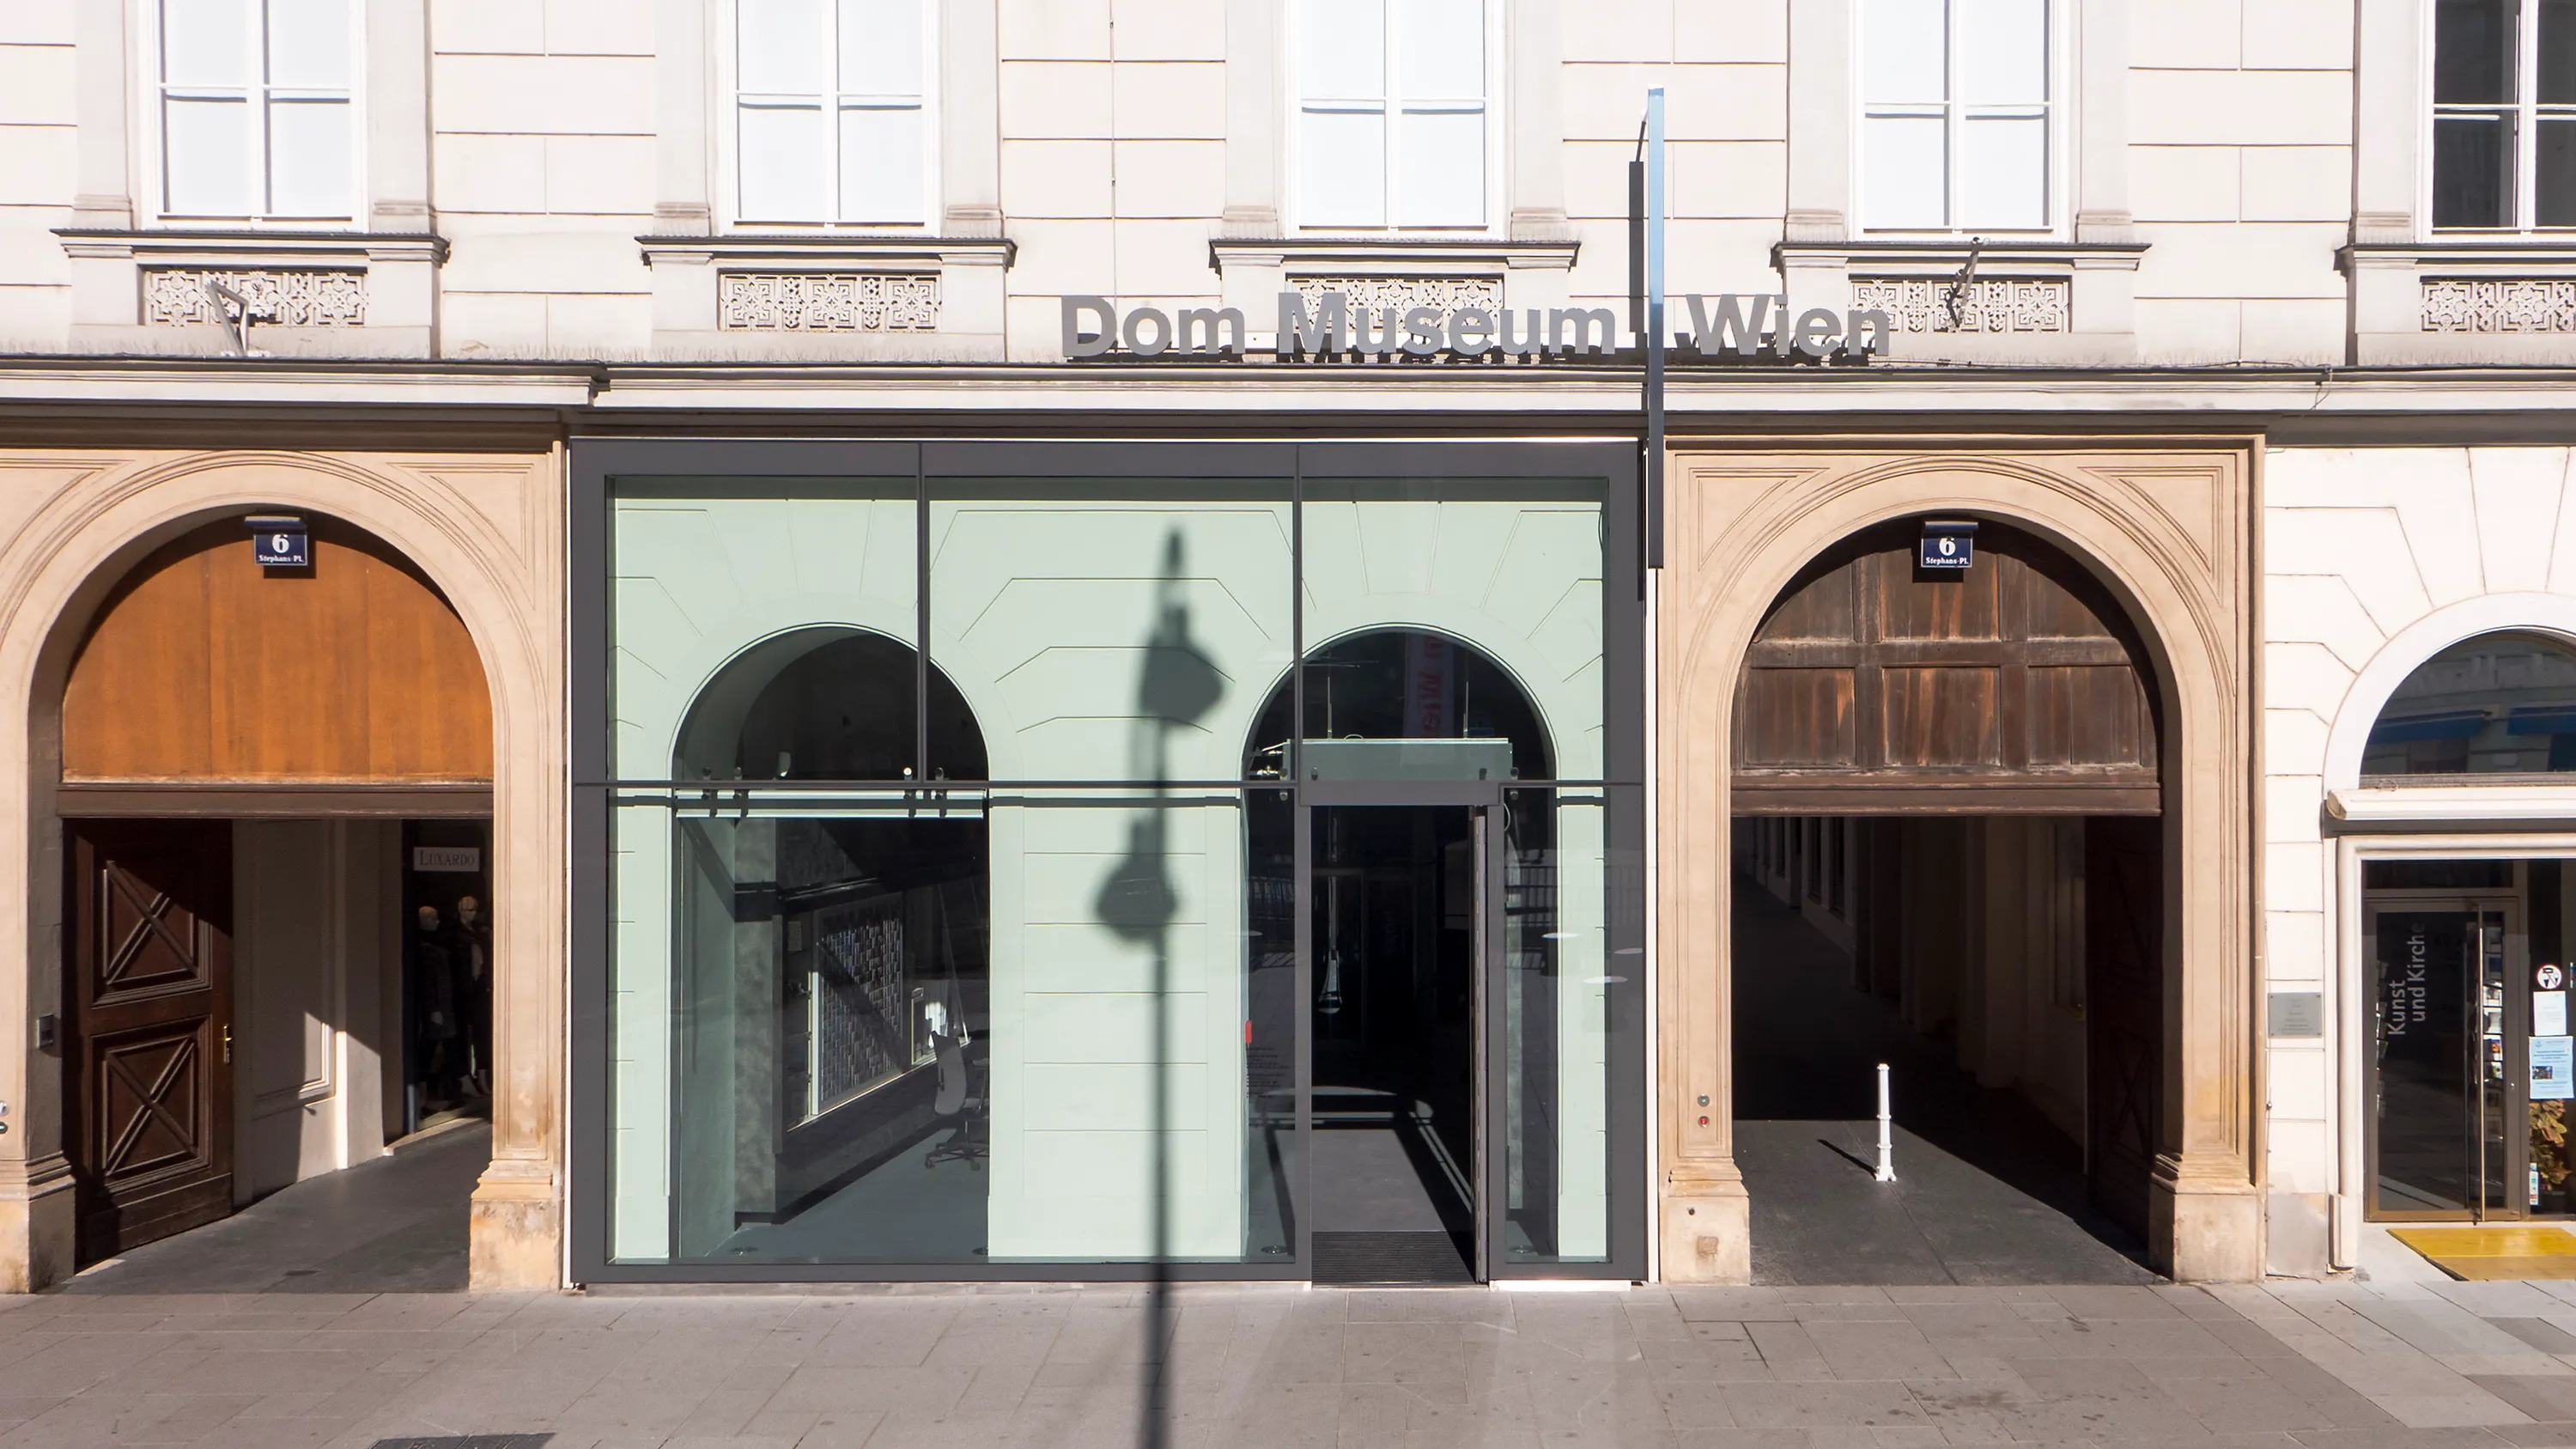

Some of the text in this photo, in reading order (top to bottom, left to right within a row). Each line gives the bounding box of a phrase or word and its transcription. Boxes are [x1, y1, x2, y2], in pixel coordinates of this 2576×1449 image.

[1061, 292, 1890, 357] Dom Museum Wien
[272, 533, 289, 554] 6
[1939, 538, 1956, 557] 6
[2406, 923, 2426, 1021] und Kirche
[2387, 980, 2406, 1035] Kunst
